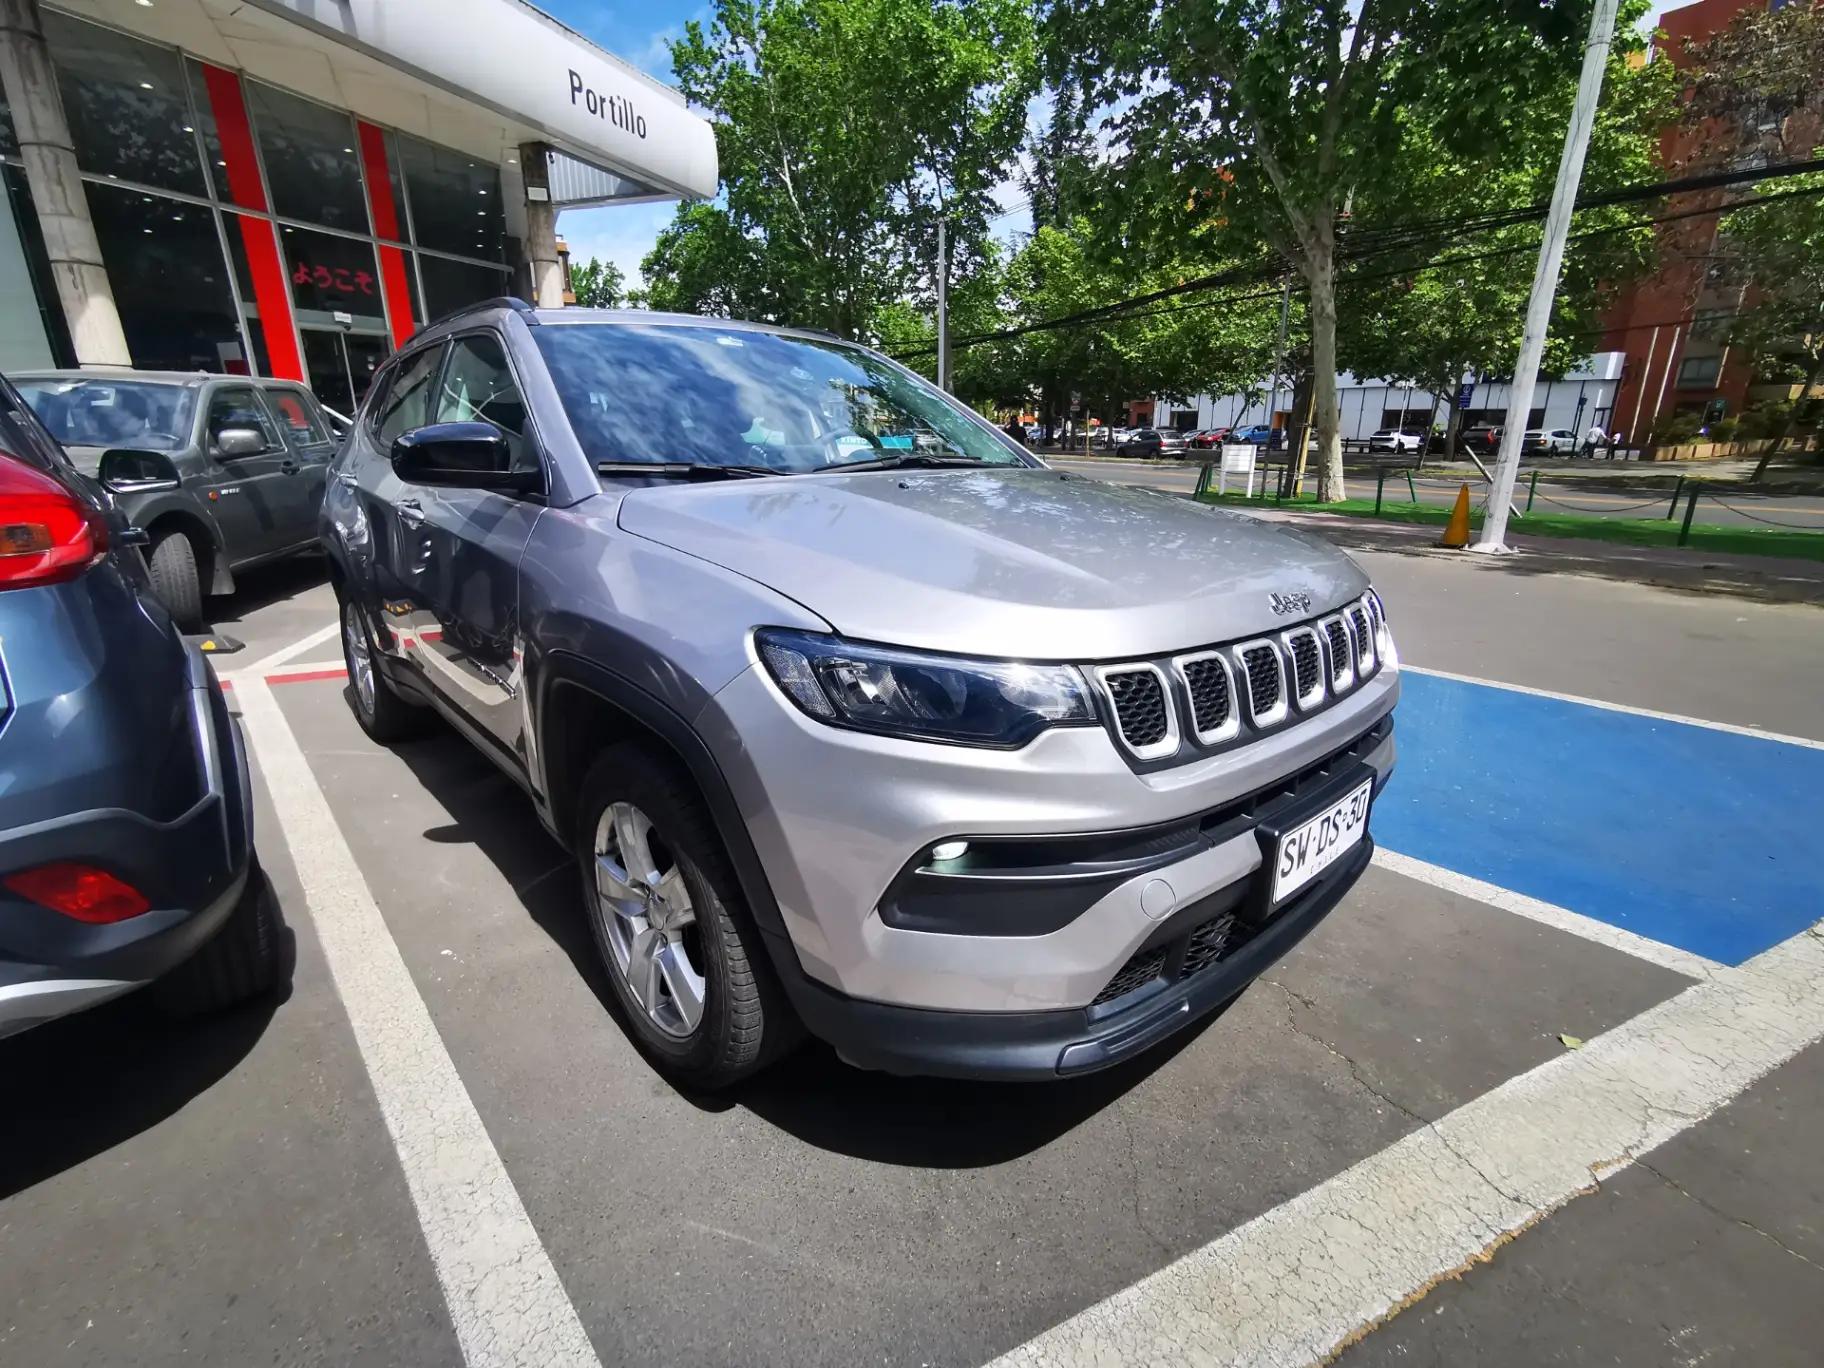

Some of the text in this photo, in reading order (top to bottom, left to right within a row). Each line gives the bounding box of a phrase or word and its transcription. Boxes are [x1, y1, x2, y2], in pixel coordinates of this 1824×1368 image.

[568, 68, 646, 139] Portillo
[292, 262, 374, 295] ようこそ
[1268, 592, 1311, 616] Jeep
